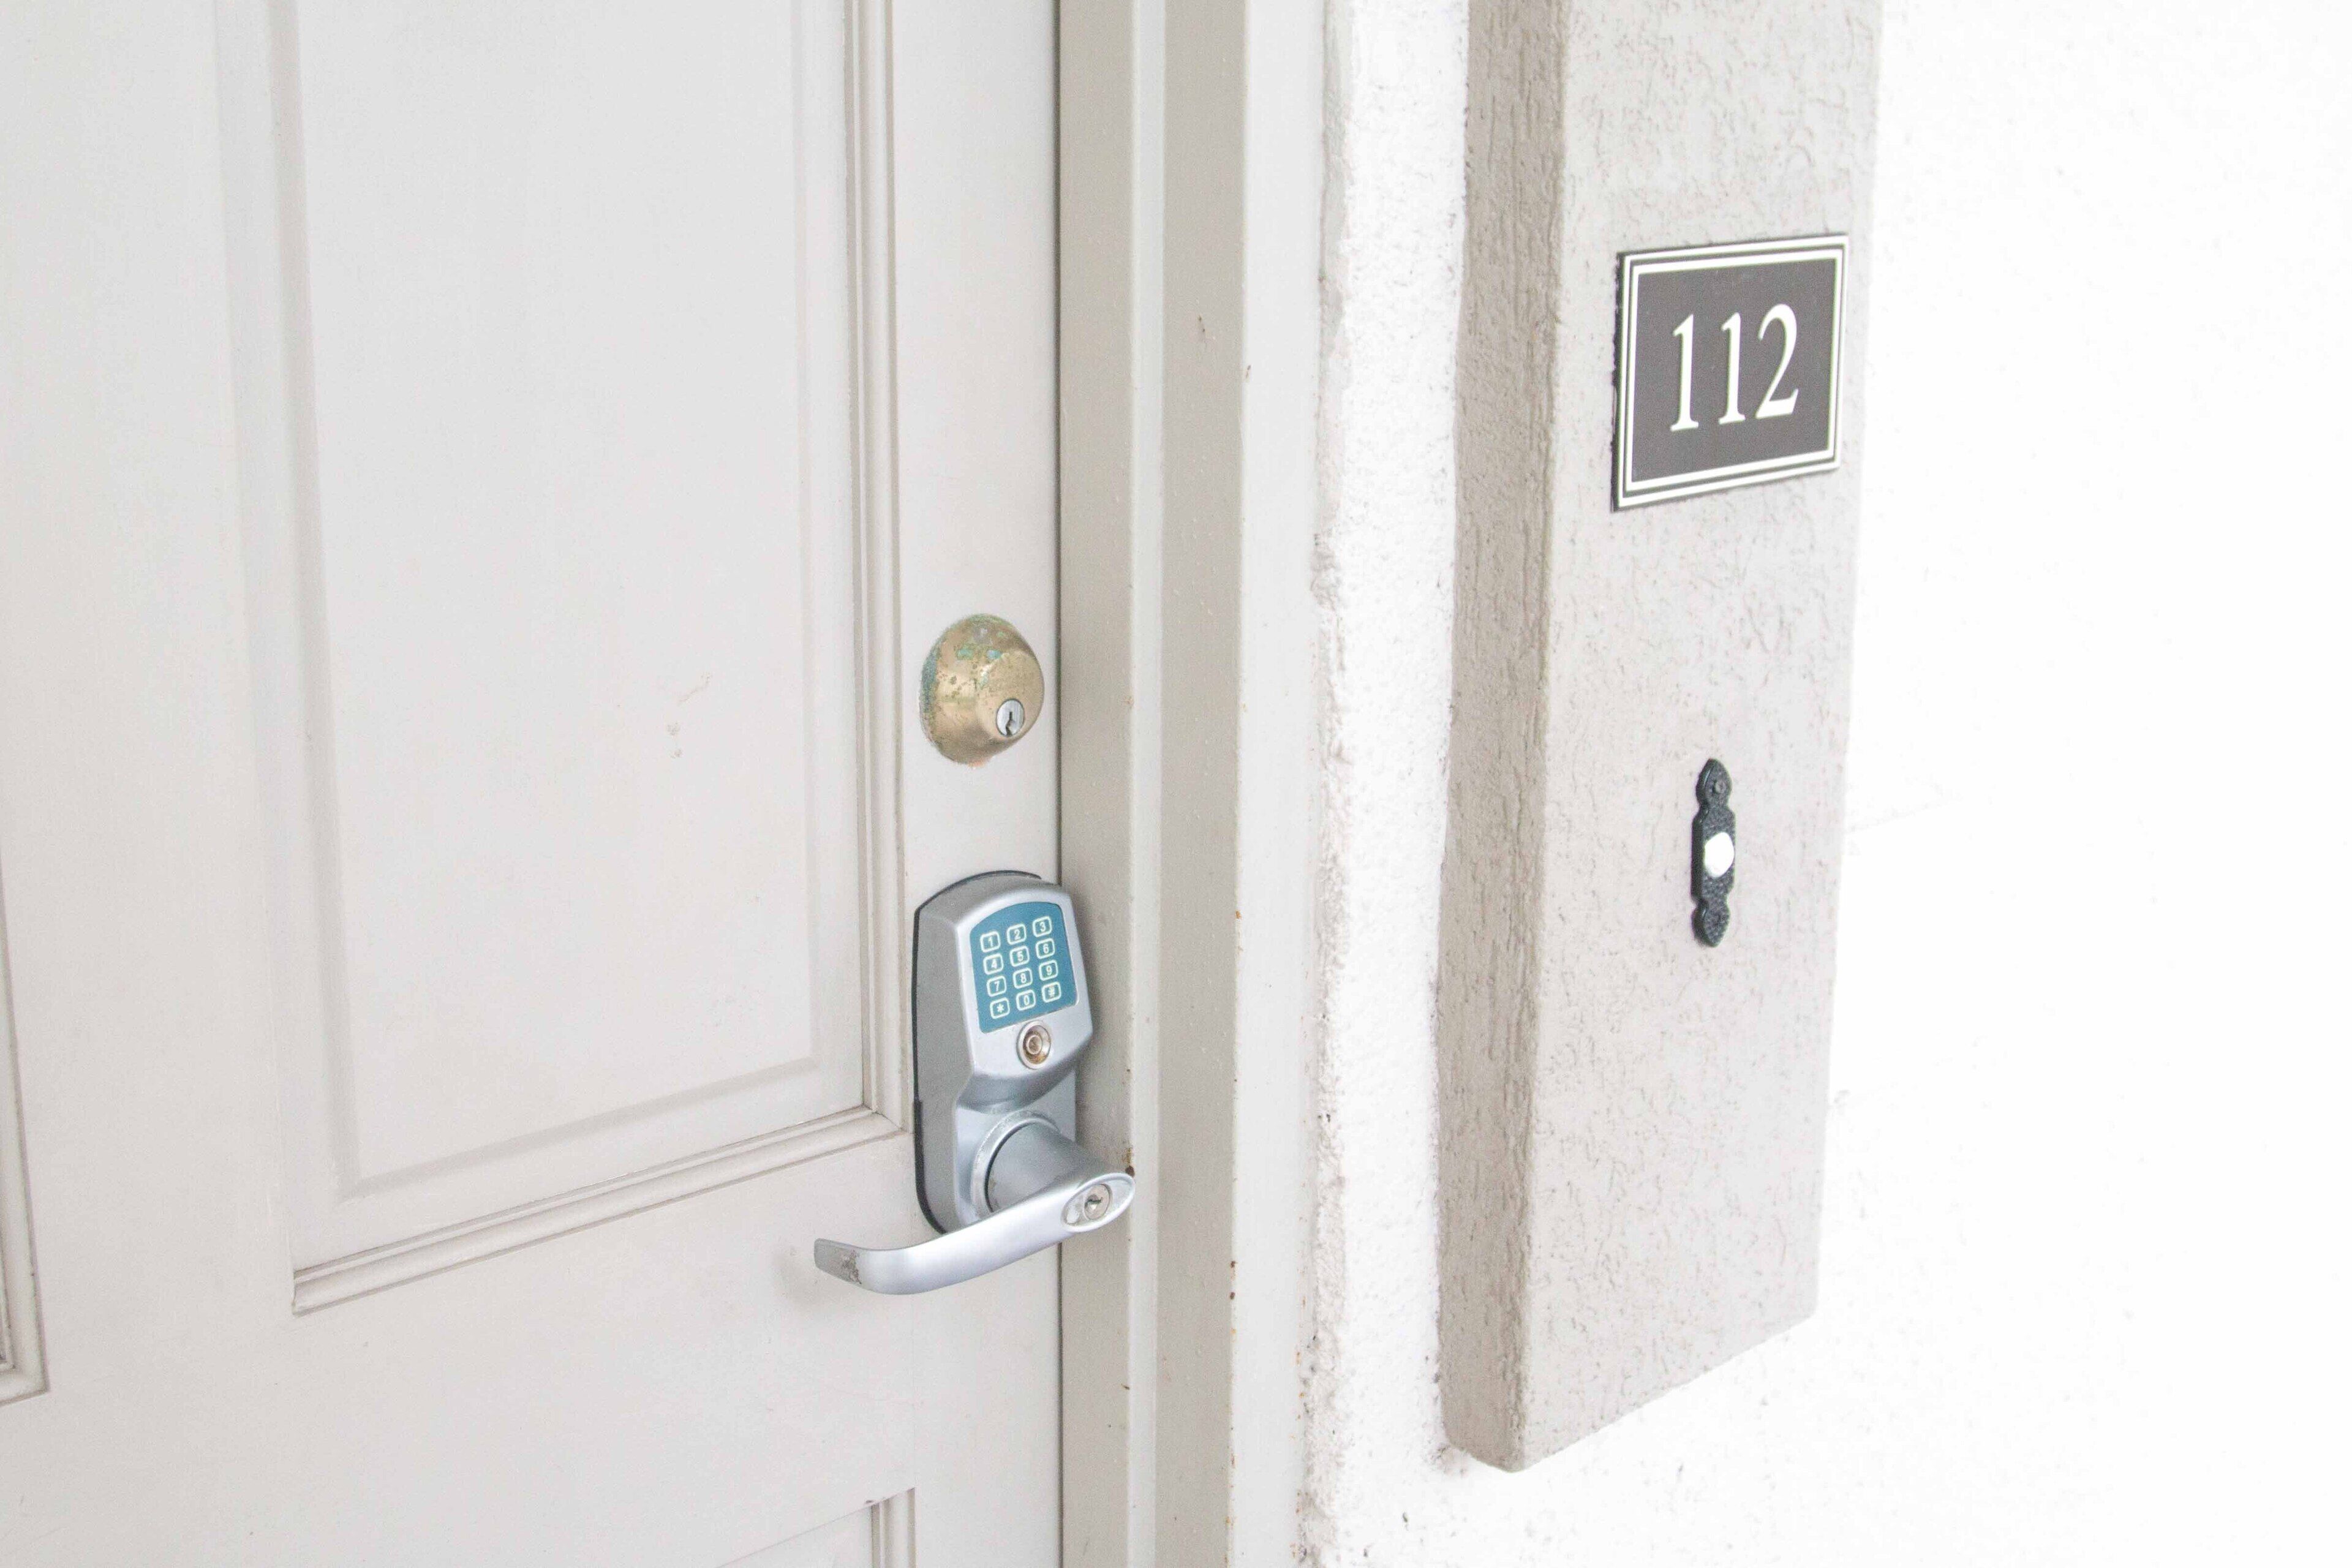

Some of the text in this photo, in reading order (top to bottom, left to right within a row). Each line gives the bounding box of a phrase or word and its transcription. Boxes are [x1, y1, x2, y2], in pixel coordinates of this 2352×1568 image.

[1670, 304, 1799, 432] 112
[988, 921, 1046, 947] 1 2 3
[991, 944, 1049, 970] 4 5 6
[994, 965, 1052, 992] 7 8 9
[1023, 995, 1030, 1006] 0
